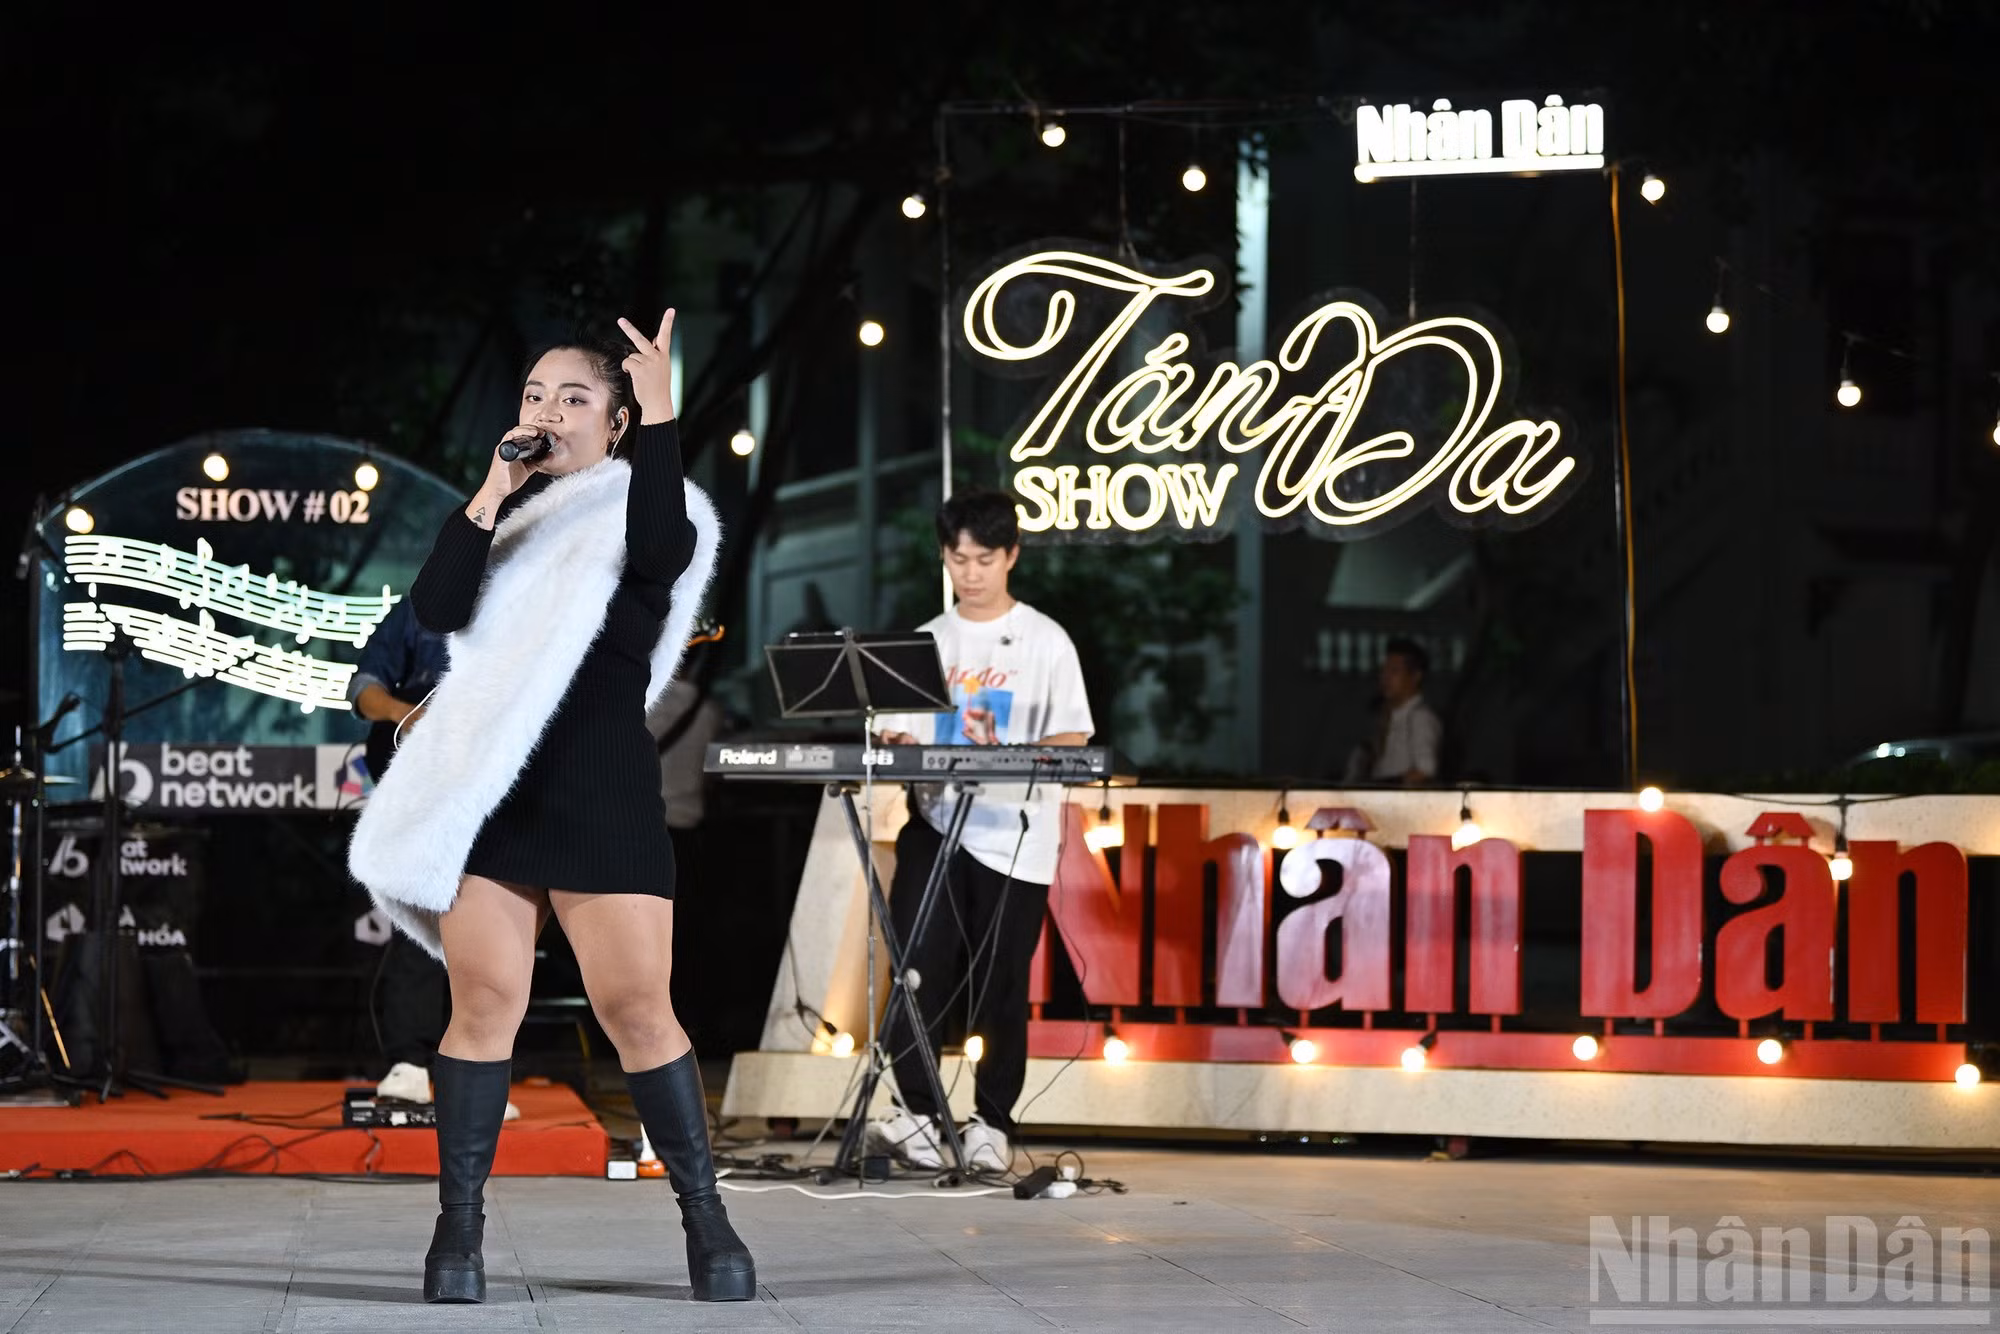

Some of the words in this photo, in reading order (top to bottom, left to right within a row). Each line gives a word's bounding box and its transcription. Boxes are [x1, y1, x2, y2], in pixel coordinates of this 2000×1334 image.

[1356, 98, 1493, 163] Nhân
[1501, 94, 1604, 158] Dân
[176, 487, 298, 523] SHOW
[1014, 463, 1239, 532] SHOW
[161, 742, 253, 777] beat
[719, 748, 777, 765] Roland
[161, 775, 317, 808] network
[1027, 803, 1523, 1015] Nhân
[1580, 808, 1969, 1024] Dân
